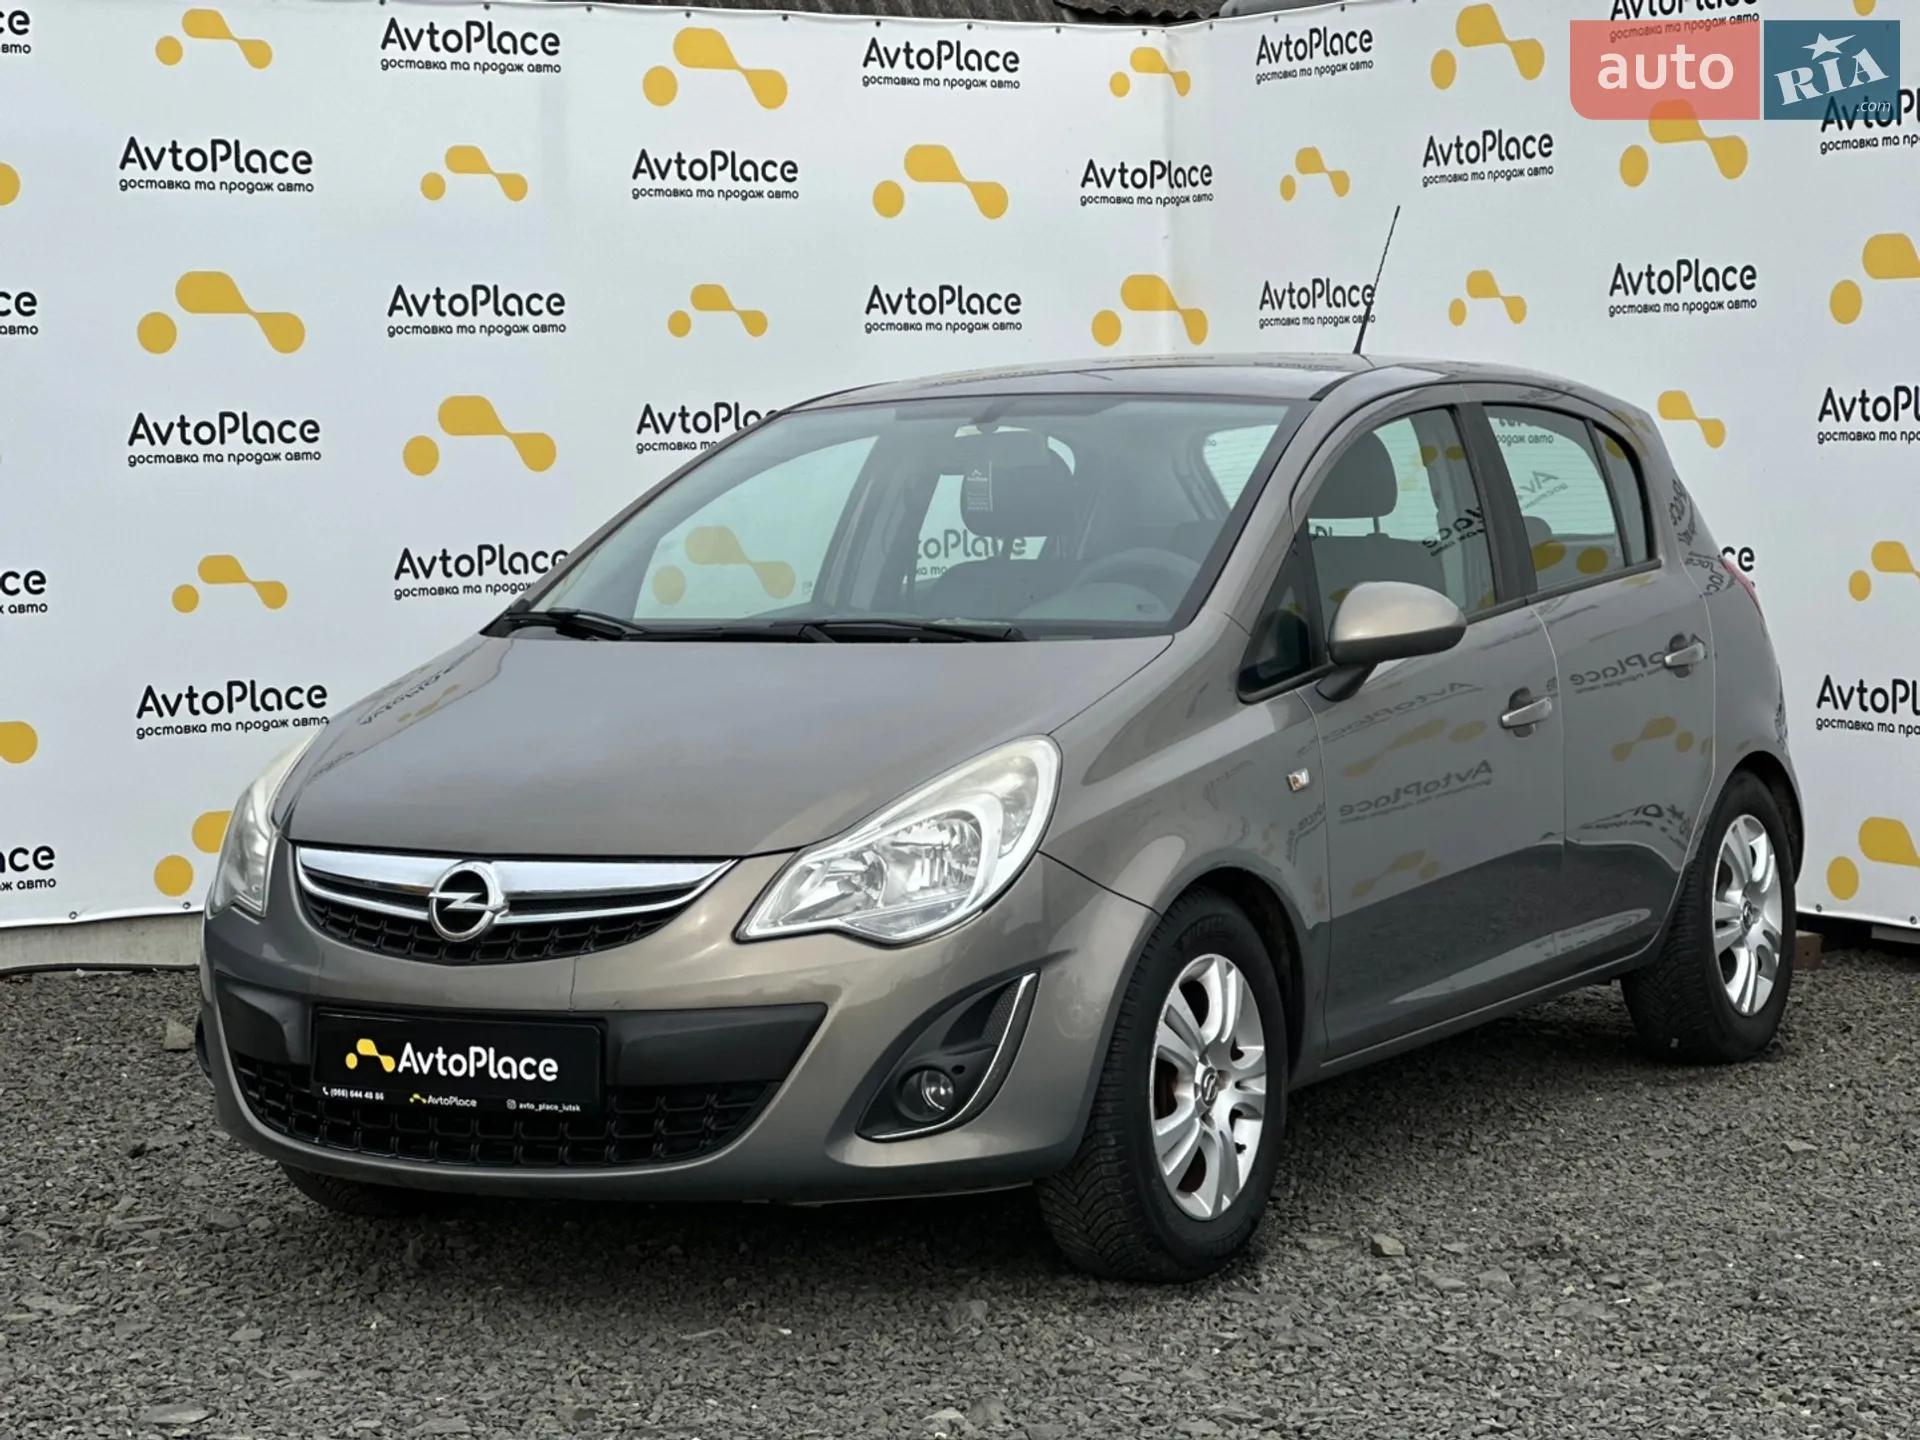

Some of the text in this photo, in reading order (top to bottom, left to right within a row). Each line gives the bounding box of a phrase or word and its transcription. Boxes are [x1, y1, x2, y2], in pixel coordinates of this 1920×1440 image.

[1, 43, 32, 55] вто
[381, 17, 561, 57] AvtoPlace
[1256, 26, 1373, 66] AvtoPlace
[381, 58, 562, 75] доставка та продаж авто
[862, 37, 1020, 74] AvtoPlace
[862, 75, 1021, 91] доставка та продаж авто
[1820, 86, 1920, 133] AvtoPl
[119, 136, 313, 175] AvtoPlace
[1422, 129, 1554, 168] AvtoPlace
[1819, 138, 1879, 156] доставка
[1882, 135, 1900, 147] та
[631, 148, 799, 183] AvtoPlace
[1080, 158, 1213, 190] AvtoPlace
[1422, 165, 1554, 188] доставка та продаж авто
[119, 178, 315, 195] доставка та продаж авто
[631, 187, 799, 202] доставка та продаж авто
[1609, 258, 1757, 297] AvtoPlace
[387, 284, 566, 318] AvtoPlace
[865, 284, 1022, 316] AvtoPlace
[1259, 277, 1375, 311] AvtoPlace
[1352, 314, 1376, 324] аво
[1609, 298, 1758, 318] доставка та продаж авто
[387, 323, 567, 338] доставка та продаж авто
[865, 322, 1023, 335] доставка та продаж авто
[1817, 385, 1920, 423] AvtoPl
[127, 410, 321, 447] AvtoPlace
[636, 401, 778, 435] AvtoPla
[636, 441, 697, 455] доставка
[1817, 431, 1876, 445] доставка
[1879, 430, 1898, 442] та
[127, 451, 322, 467] доставка та продаж авто
[394, 585, 460, 601] доставка
[463, 584, 482, 594] та
[8, 602, 48, 615] авто
[136, 679, 328, 720] AvtoPlace
[1816, 674, 1920, 717] AvtoPl
[136, 715, 329, 740] доставка та продаж авто
[1815, 717, 1875, 732] доставка
[1877, 722, 1896, 734] та
[17, 878, 57, 890] авто
[398, 1042, 559, 1082] AvtoPlace
[427, 1094, 478, 1108] AvtoPlace
